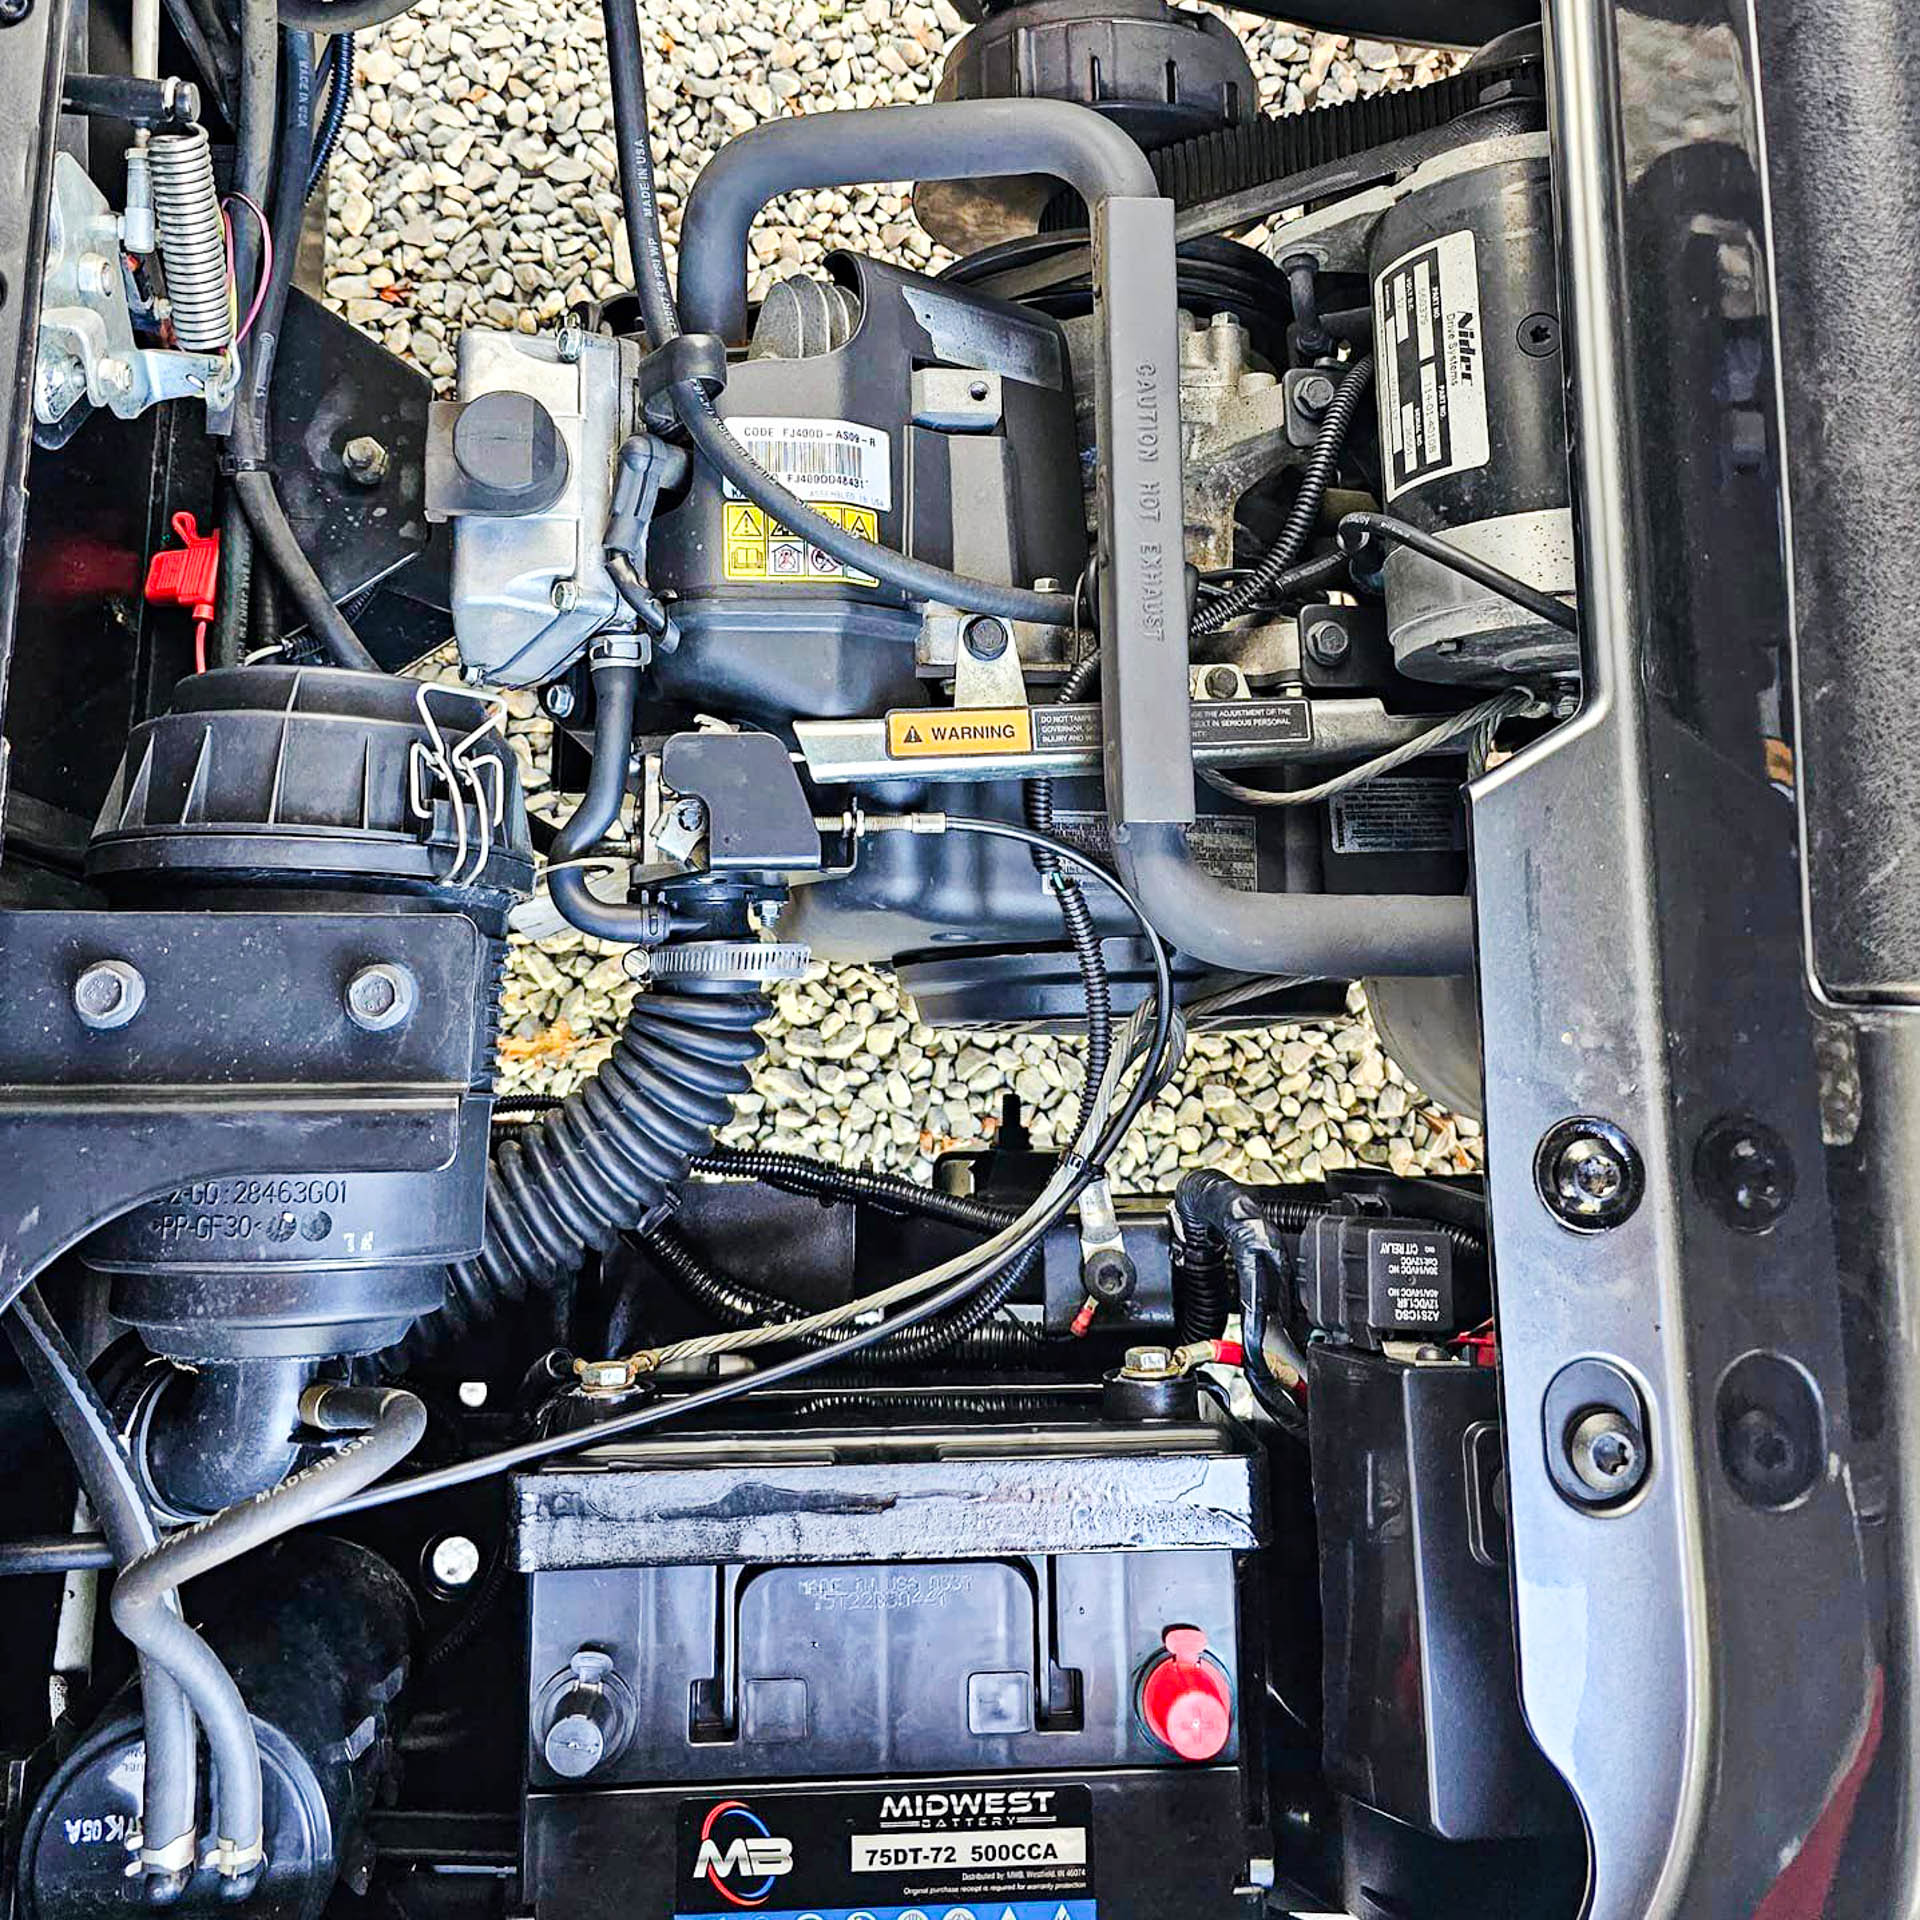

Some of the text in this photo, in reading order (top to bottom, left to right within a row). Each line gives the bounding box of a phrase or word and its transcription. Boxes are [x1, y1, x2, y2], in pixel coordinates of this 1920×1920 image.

[633, 137, 647, 163] USA
[638, 168, 649, 181] IN
[638, 182, 654, 217] MADE
[647, 237, 660, 258] WP
[1446, 312, 1459, 386] Drive Systems
[1457, 311, 1477, 387] Nidec
[744, 427, 774, 438] CODE
[1136, 363, 1166, 643] CAUTION HOT EXHAUST
[1041, 716, 1052, 724] DO
[1053, 715, 1069, 723] NOT
[1219, 708, 1264, 718] ADJUSTMENT
[1277, 707, 1291, 716] THE
[1220, 719, 1251, 728] SERIOUS
[1253, 717, 1291, 727] PERSONAL
[931, 724, 1016, 741] WARNING
[1380, 1242, 1405, 1255] RELAY
[256, 1468, 313, 1504] MADE
[314, 1456, 337, 1472] IN
[879, 1791, 1056, 1818] MIDWEST
[921, 1816, 1017, 1828] BATTERY
[693, 1838, 793, 1878] MB
[866, 1843, 1058, 1866] 75DT-72 500CCA
[929, 1886, 959, 1895] purchase
[1054, 1881, 1087, 1891] protection
